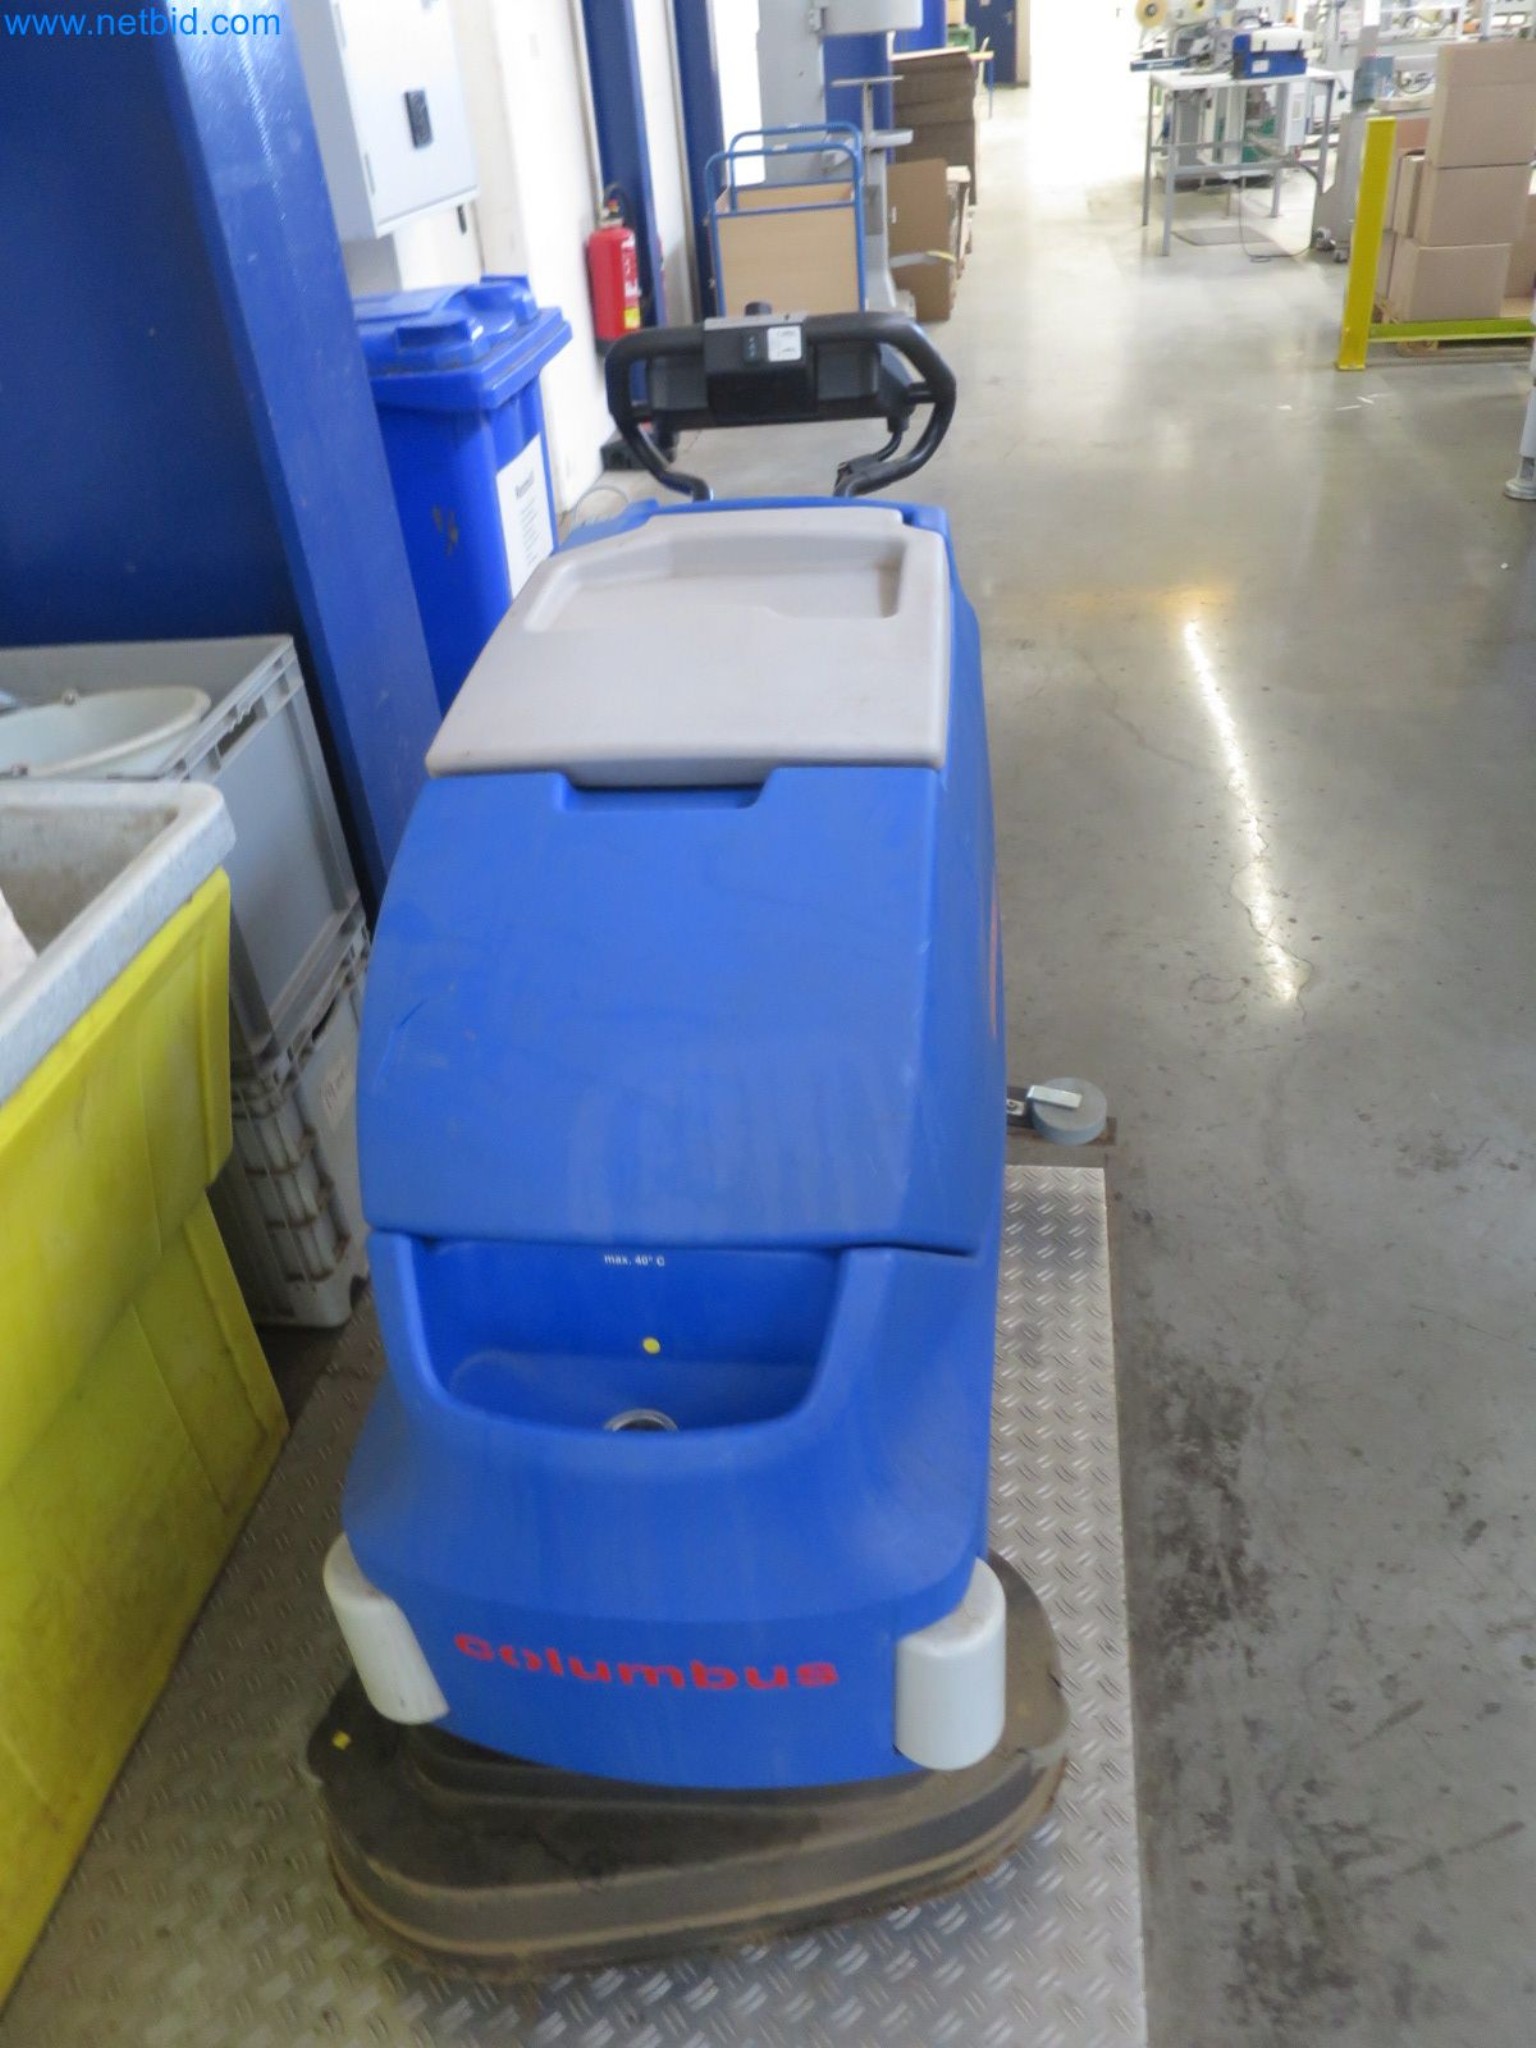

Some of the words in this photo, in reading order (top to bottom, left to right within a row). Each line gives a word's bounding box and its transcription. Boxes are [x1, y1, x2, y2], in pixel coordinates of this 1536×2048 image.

[604, 1254, 631, 1266] max.
[656, 1255, 665, 1267] C
[454, 1633, 838, 1690] columbus
